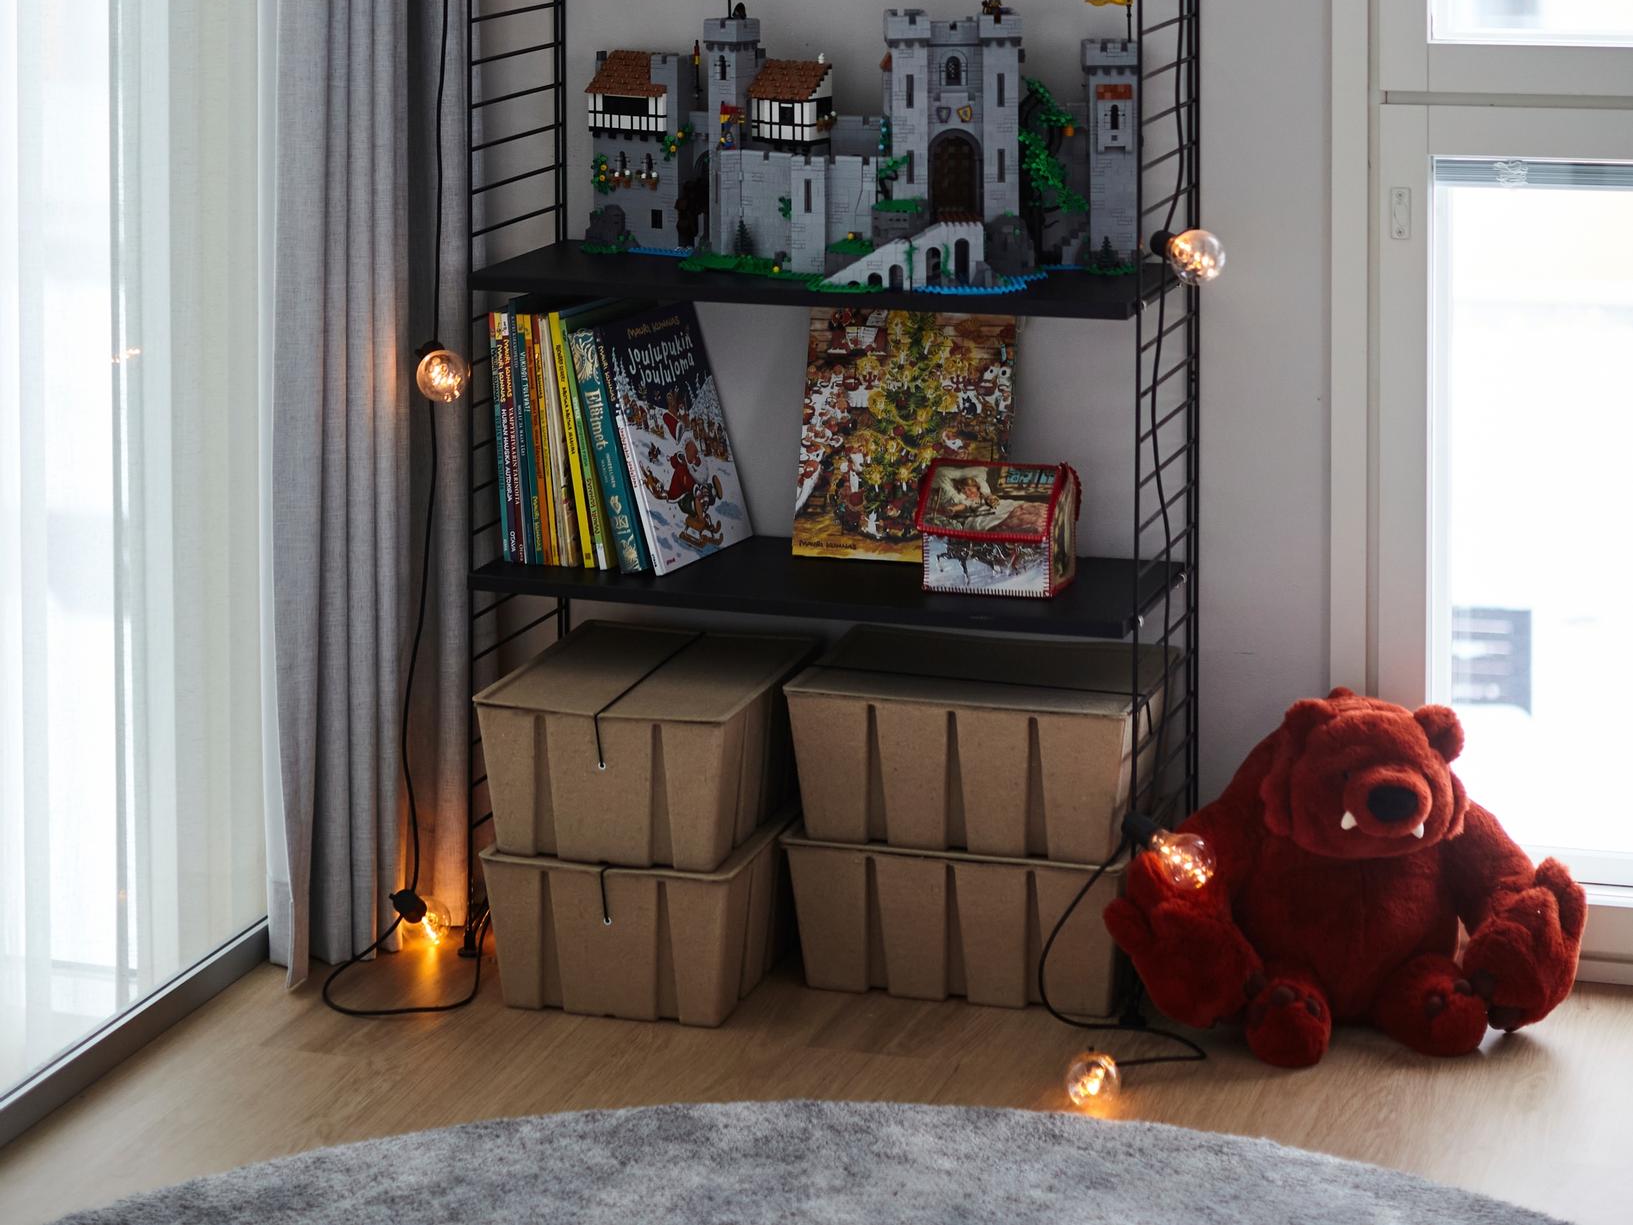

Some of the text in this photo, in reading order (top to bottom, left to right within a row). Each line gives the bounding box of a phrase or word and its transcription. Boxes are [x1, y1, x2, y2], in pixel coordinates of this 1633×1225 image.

[628, 332, 694, 375] Joulupukin
[639, 352, 695, 386] joululoma
[501, 408, 509, 436] HURJAN
[509, 407, 518, 469] VAMPYYRIVAARIN
[584, 388, 609, 451] Eläimet
[512, 470, 520, 505] TARINOITA
